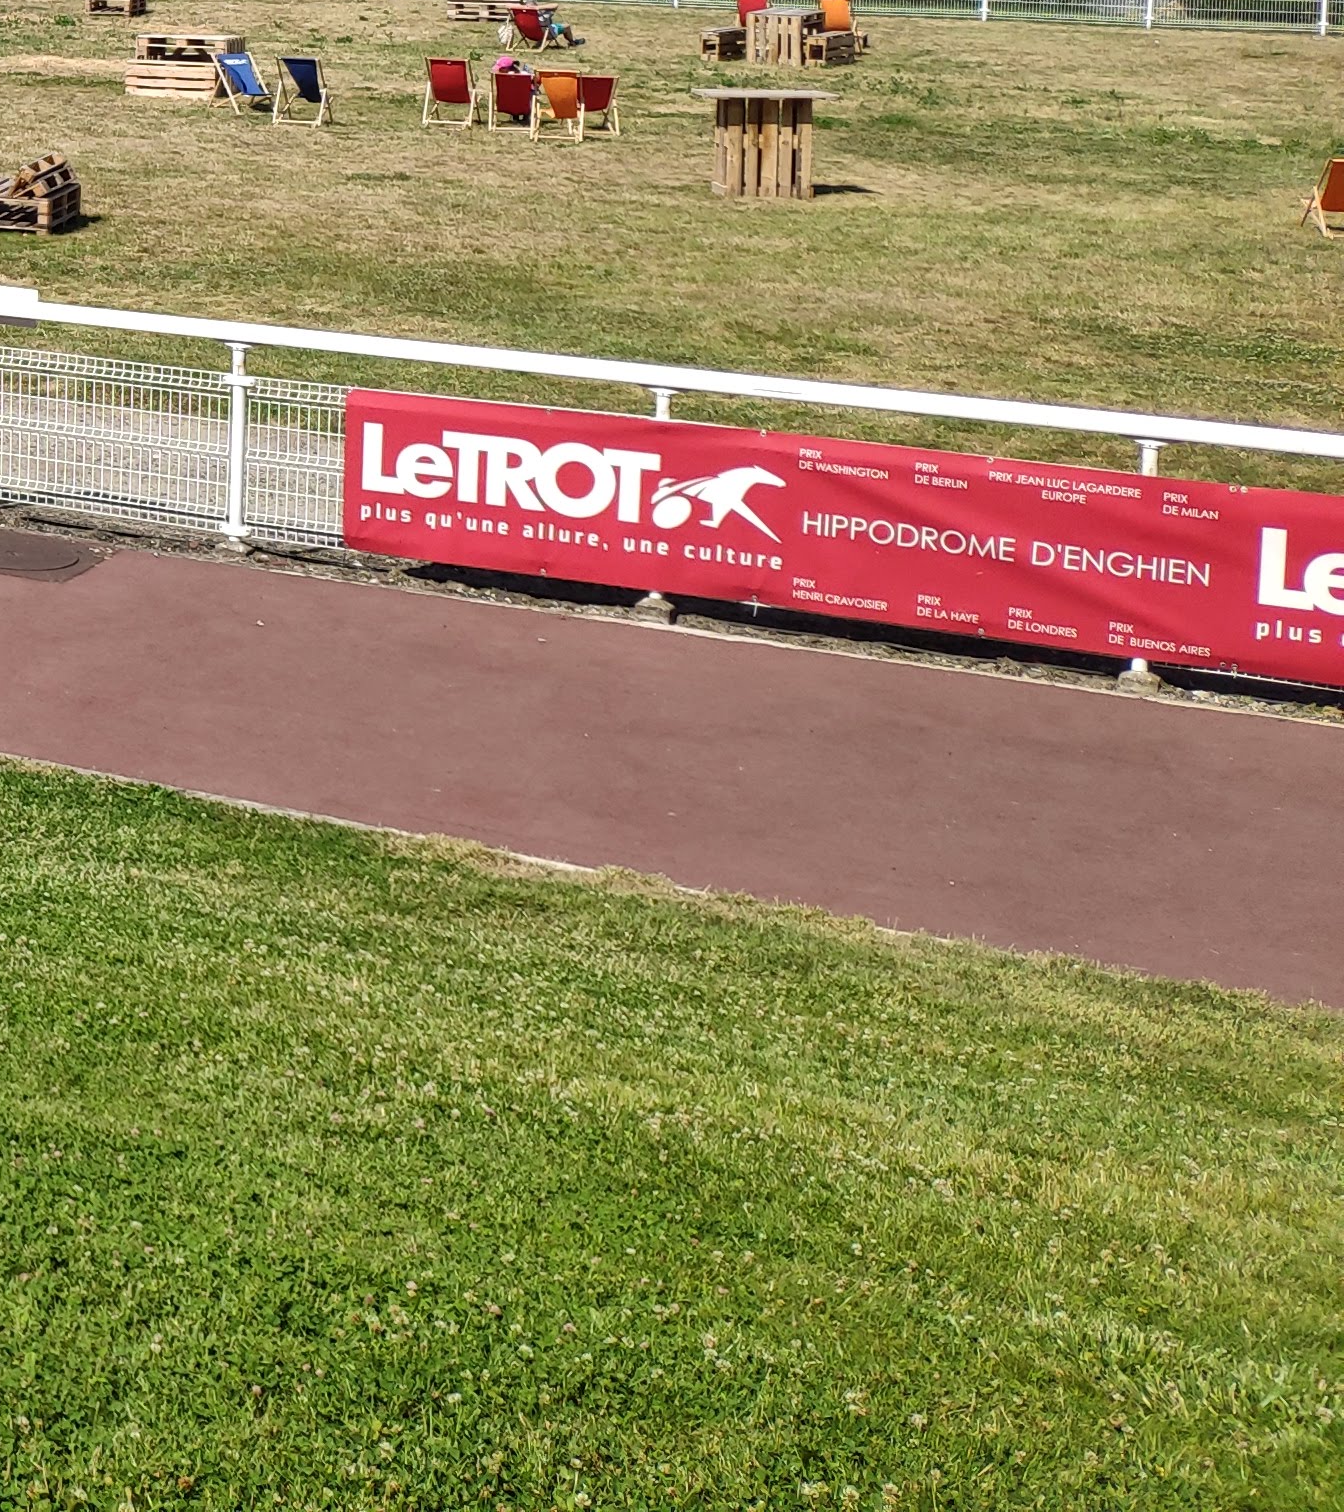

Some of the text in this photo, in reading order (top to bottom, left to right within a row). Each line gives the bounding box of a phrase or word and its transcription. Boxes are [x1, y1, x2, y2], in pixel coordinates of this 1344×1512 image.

[799, 448, 822, 460] PRIX
[362, 421, 661, 524] LeTROT
[798, 460, 889, 480] DE WASHINGTON
[915, 462, 939, 474] PRIX
[914, 474, 968, 490] DE BERLIN
[988, 470, 1142, 499] PRIX JEAN LUC LAGARDERE
[1041, 490, 1087, 505] EUROPE
[1163, 492, 1188, 504] PRIX
[1162, 504, 1219, 521] DE MILAN
[360, 503, 783, 570] plus qu'une allure, une culture
[802, 511, 1211, 587] HIPPODROME D'ENGHIEN
[793, 577, 816, 589] PRIX
[792, 589, 888, 612] HENRI CRAVOISIER
[917, 594, 941, 606] PRIX
[916, 606, 979, 625] DE LA HAYE
[1008, 606, 1033, 620] PRIX
[1007, 619, 1078, 638] DE LONDRES
[1108, 621, 1134, 634] PRIX
[1256, 620, 1323, 644] plus
[1108, 633, 1211, 658] DE BUENOS AIRES
